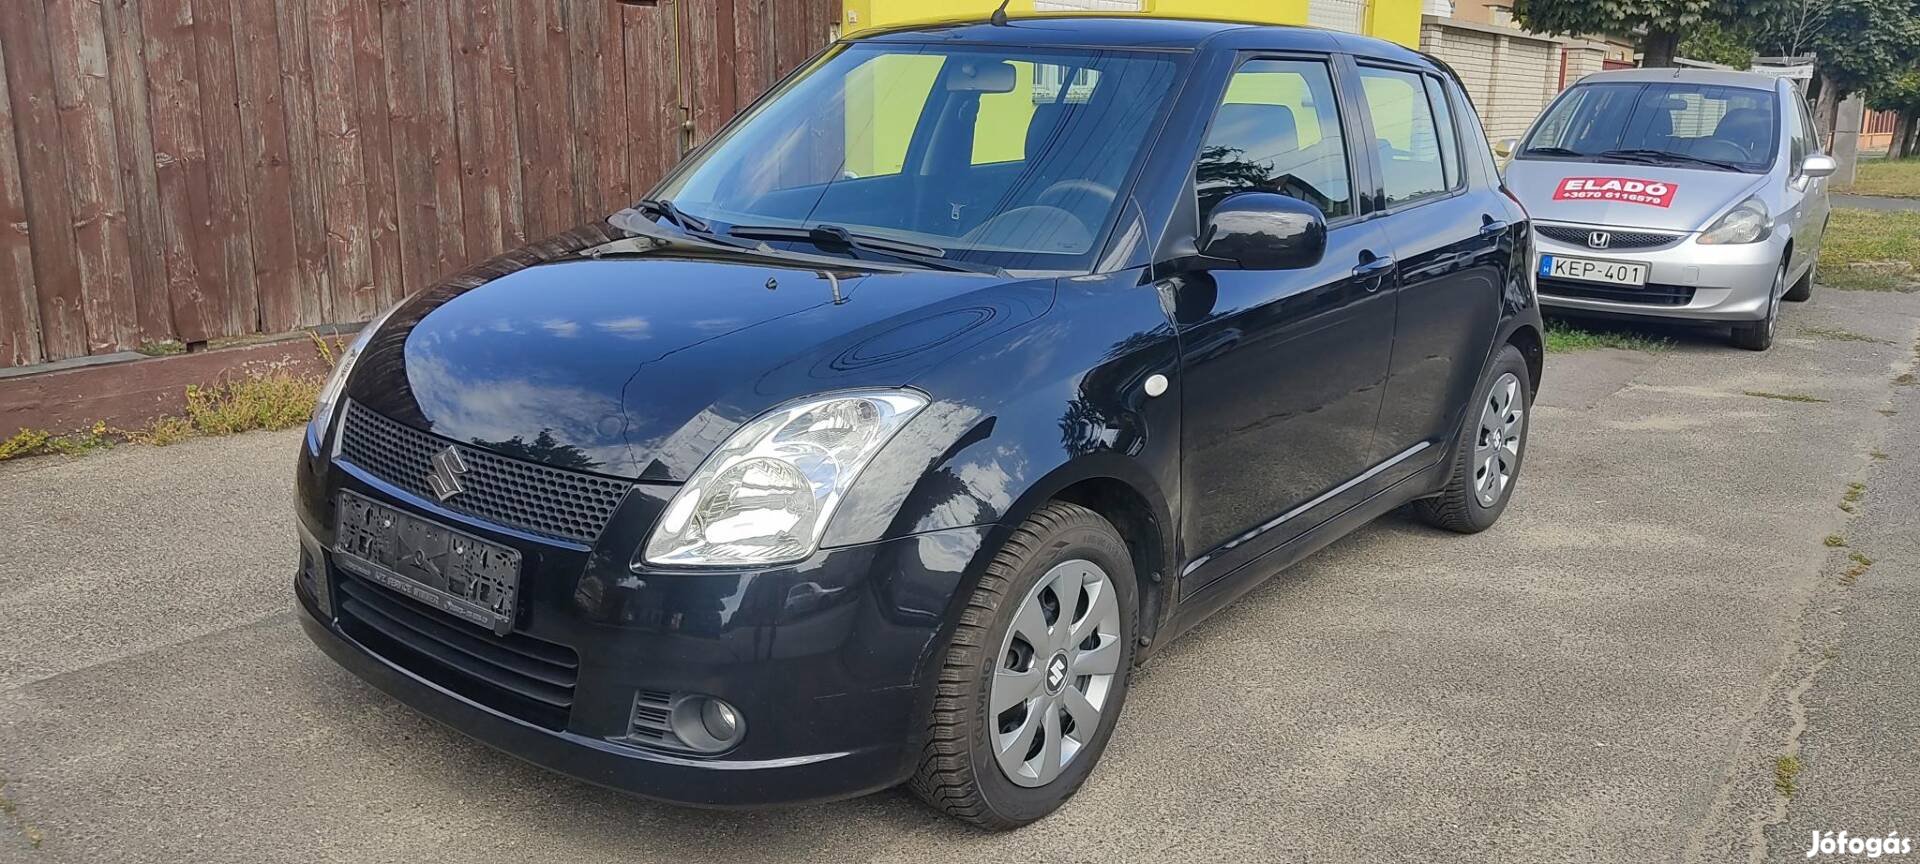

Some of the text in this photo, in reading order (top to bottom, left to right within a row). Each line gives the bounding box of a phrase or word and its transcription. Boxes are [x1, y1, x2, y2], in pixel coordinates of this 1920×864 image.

[1563, 191, 1602, 199] +3670
[1564, 179, 1668, 196] ELADÓ
[1554, 259, 1639, 283] KEP-401
